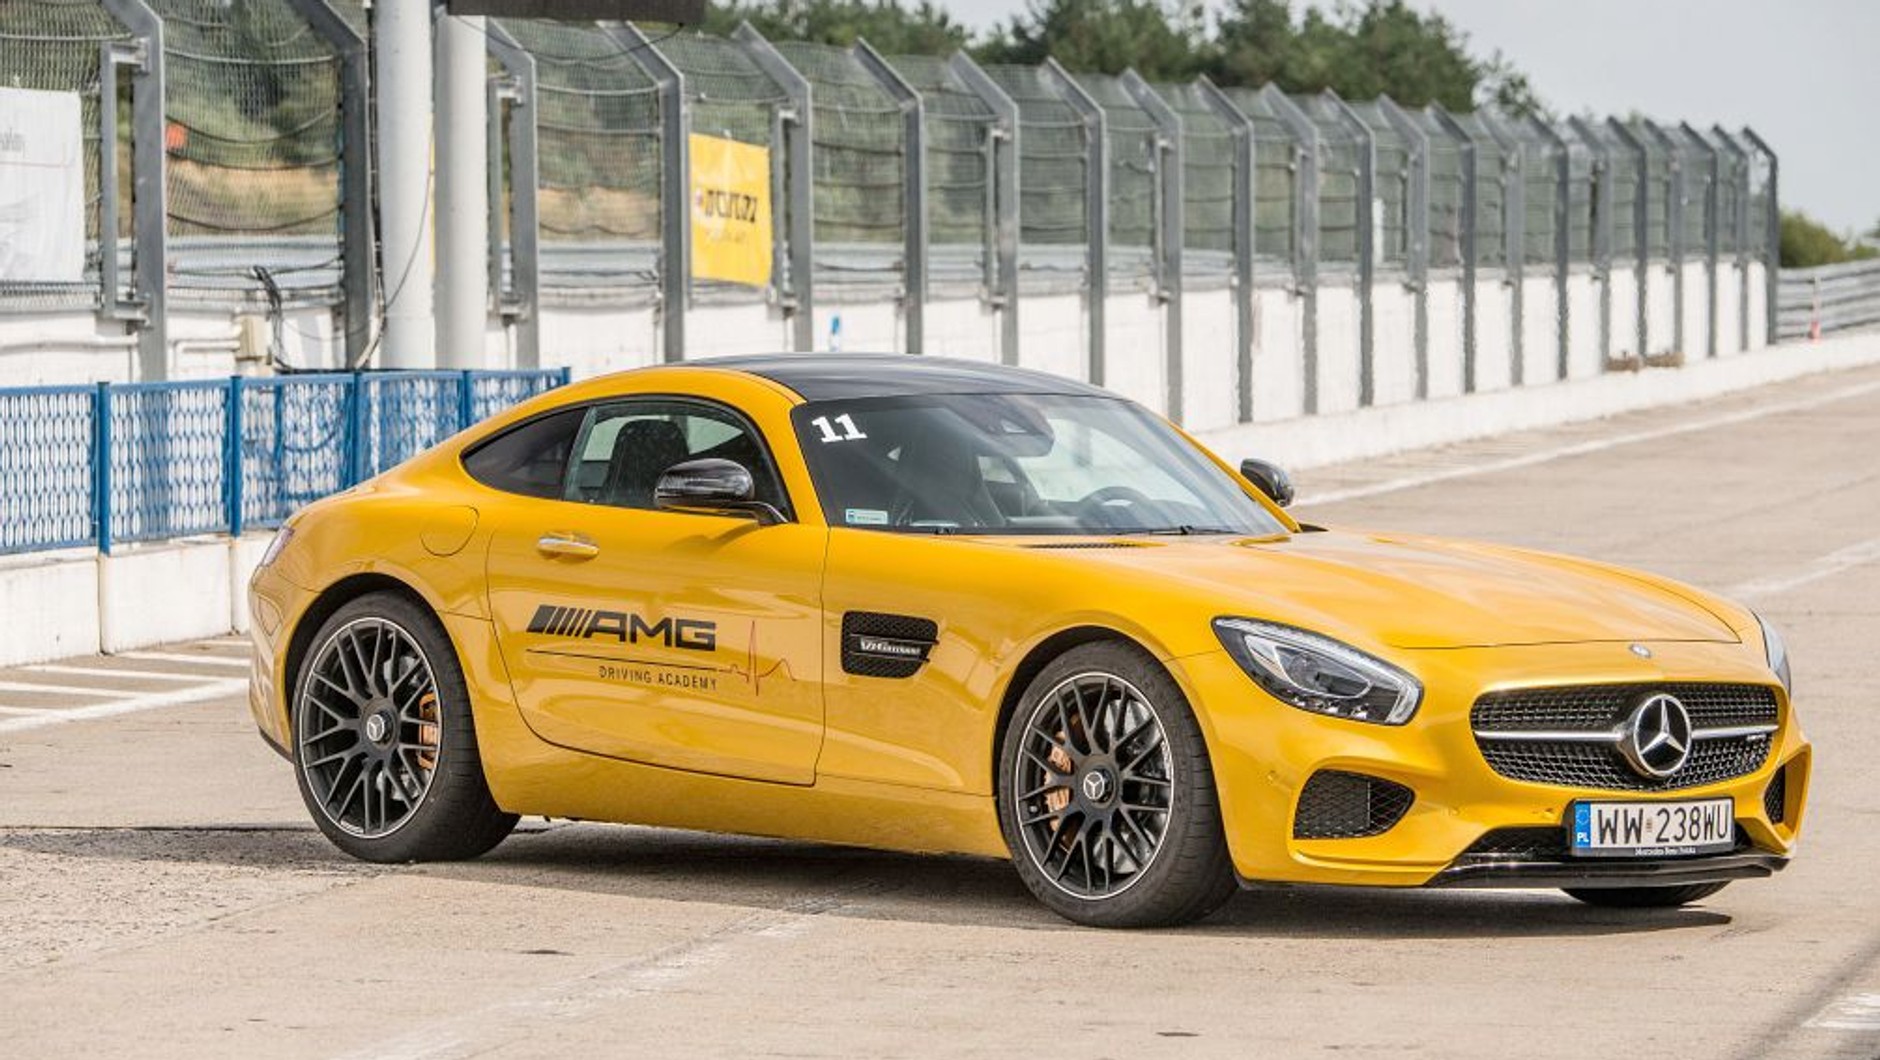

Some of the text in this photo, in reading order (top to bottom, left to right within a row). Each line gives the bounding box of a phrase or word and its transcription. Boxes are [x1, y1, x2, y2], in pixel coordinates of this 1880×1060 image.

[811, 413, 868, 443] 11
[599, 665, 717, 690] DRIVING ACADEMY
[1576, 831, 1590, 843] PL
[1597, 804, 1730, 845] WW 238WU
